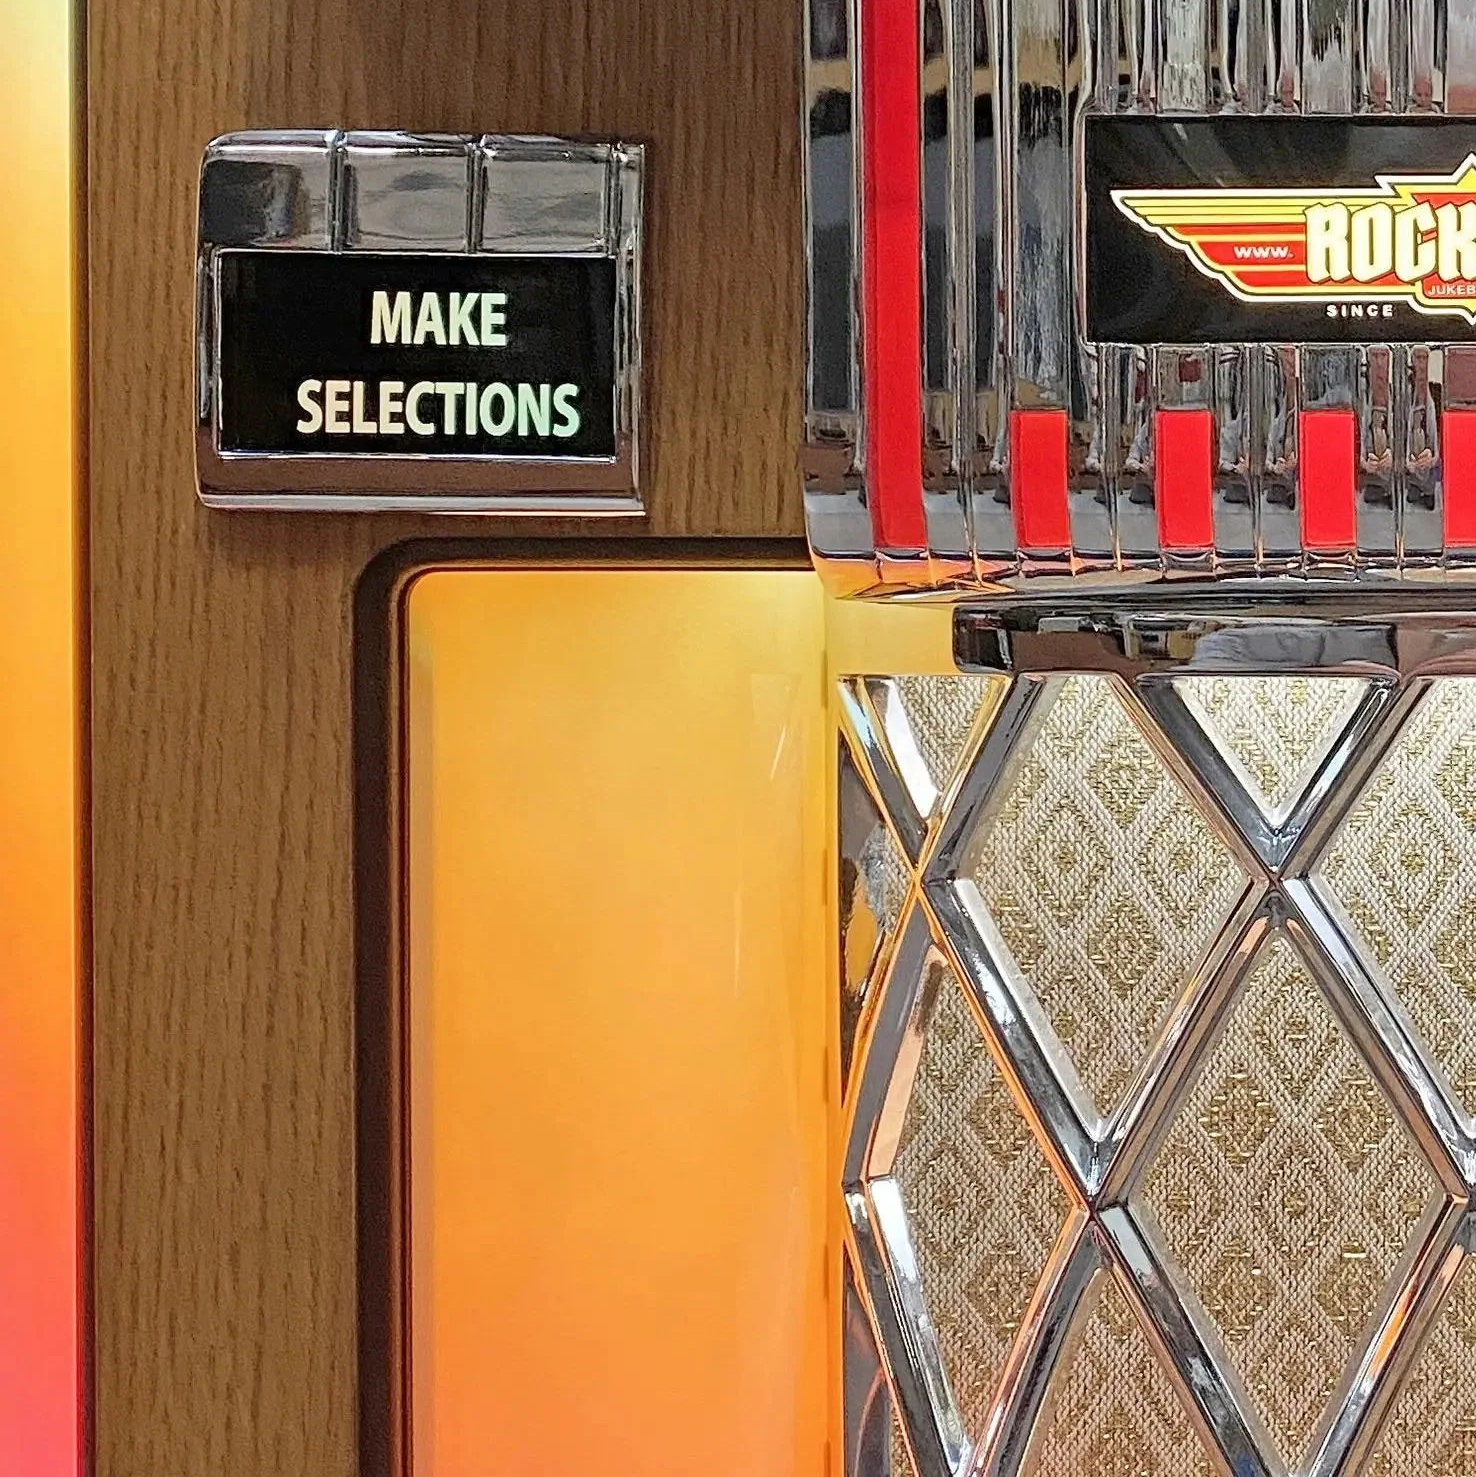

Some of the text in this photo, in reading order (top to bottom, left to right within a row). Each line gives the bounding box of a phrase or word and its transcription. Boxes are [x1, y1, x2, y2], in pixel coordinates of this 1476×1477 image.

[1233, 243, 1292, 258] www.
[370, 290, 508, 347] MAKE
[1327, 304, 1394, 318] SINCE
[297, 379, 580, 437] SELECTIONS
